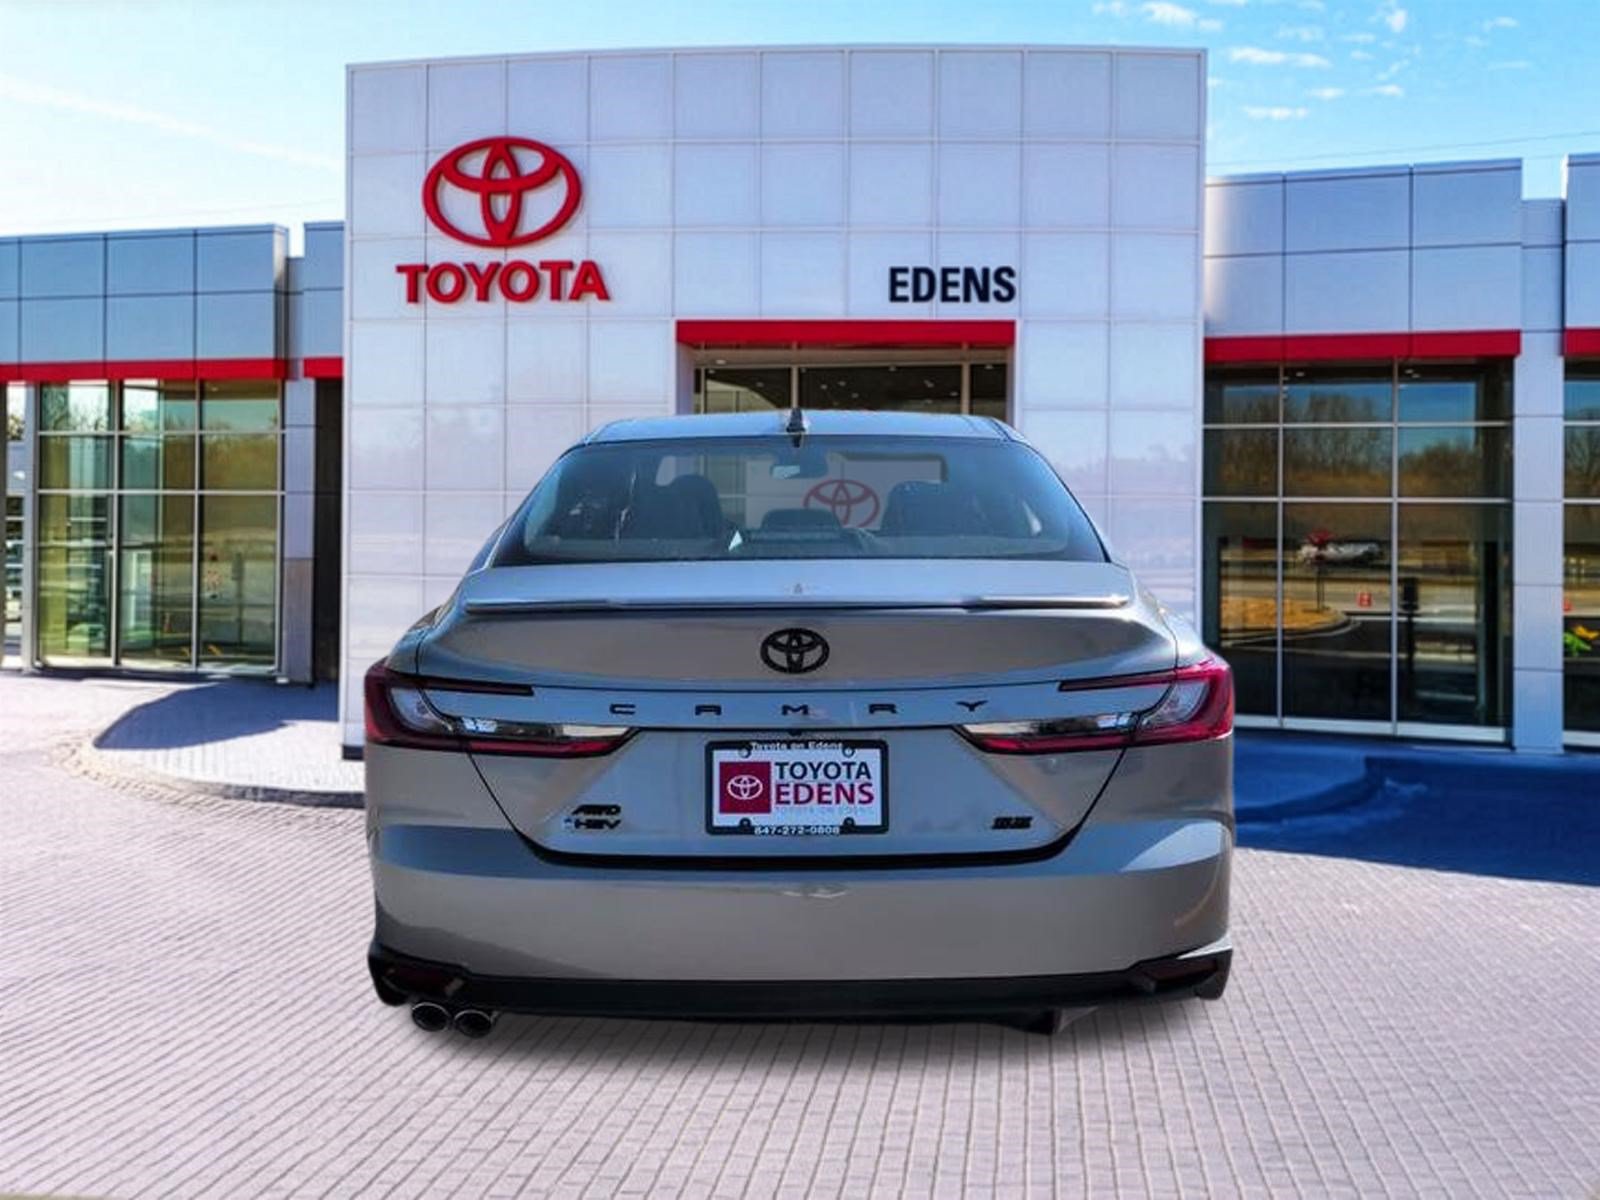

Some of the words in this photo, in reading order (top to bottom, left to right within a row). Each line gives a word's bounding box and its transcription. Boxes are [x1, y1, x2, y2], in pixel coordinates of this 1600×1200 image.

[396, 259, 610, 304] TOYOTA
[889, 266, 1017, 303] EDENS
[609, 700, 989, 717] CAMRY
[775, 762, 871, 780] TOYOTA
[776, 783, 874, 805] EDENS
